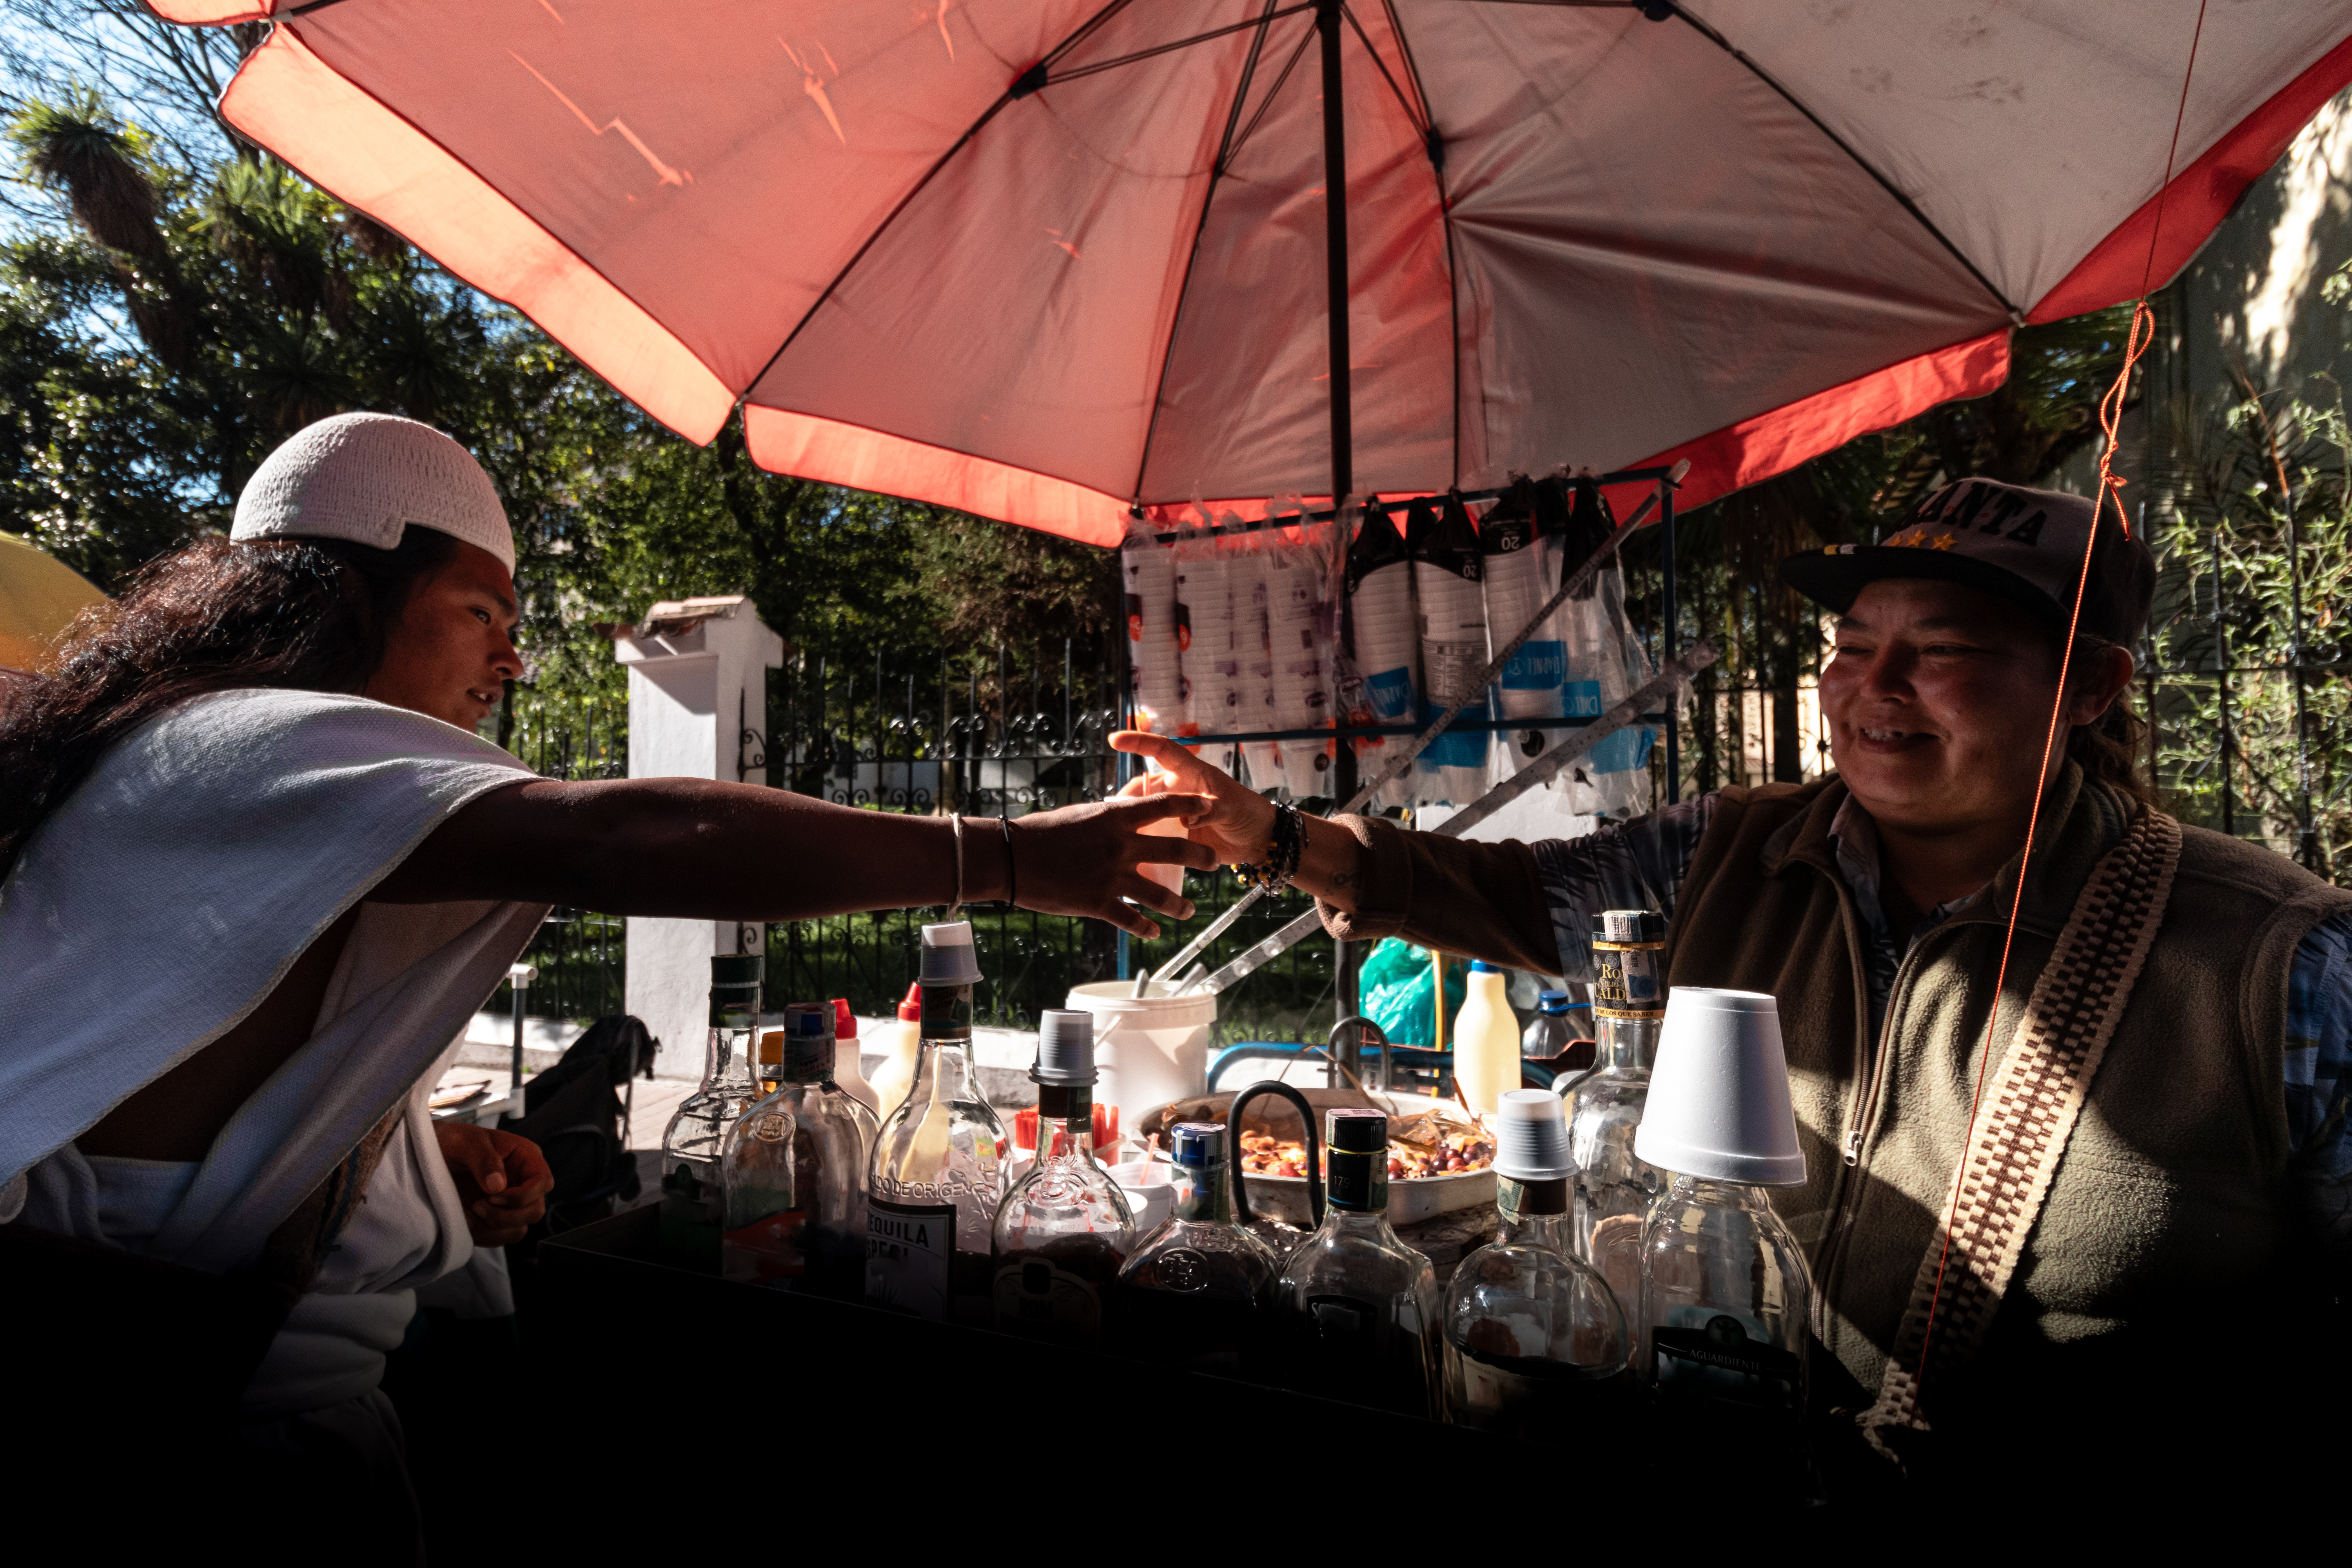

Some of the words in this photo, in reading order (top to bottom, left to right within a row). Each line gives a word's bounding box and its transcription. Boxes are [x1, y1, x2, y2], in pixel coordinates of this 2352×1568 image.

[1501, 536, 1521, 550] 20
[1463, 565, 1477, 578] 20
[1602, 964, 1622, 979] RO
[1595, 983, 1626, 1000] CALD
[893, 1179, 910, 1197] DE
[913, 1182, 972, 1198] ORIGEN
[1334, 1176, 1351, 1189] 179
[1019, 1297, 1053, 1320] RON
[1689, 1349, 1762, 1372] AGUARDIENTE
